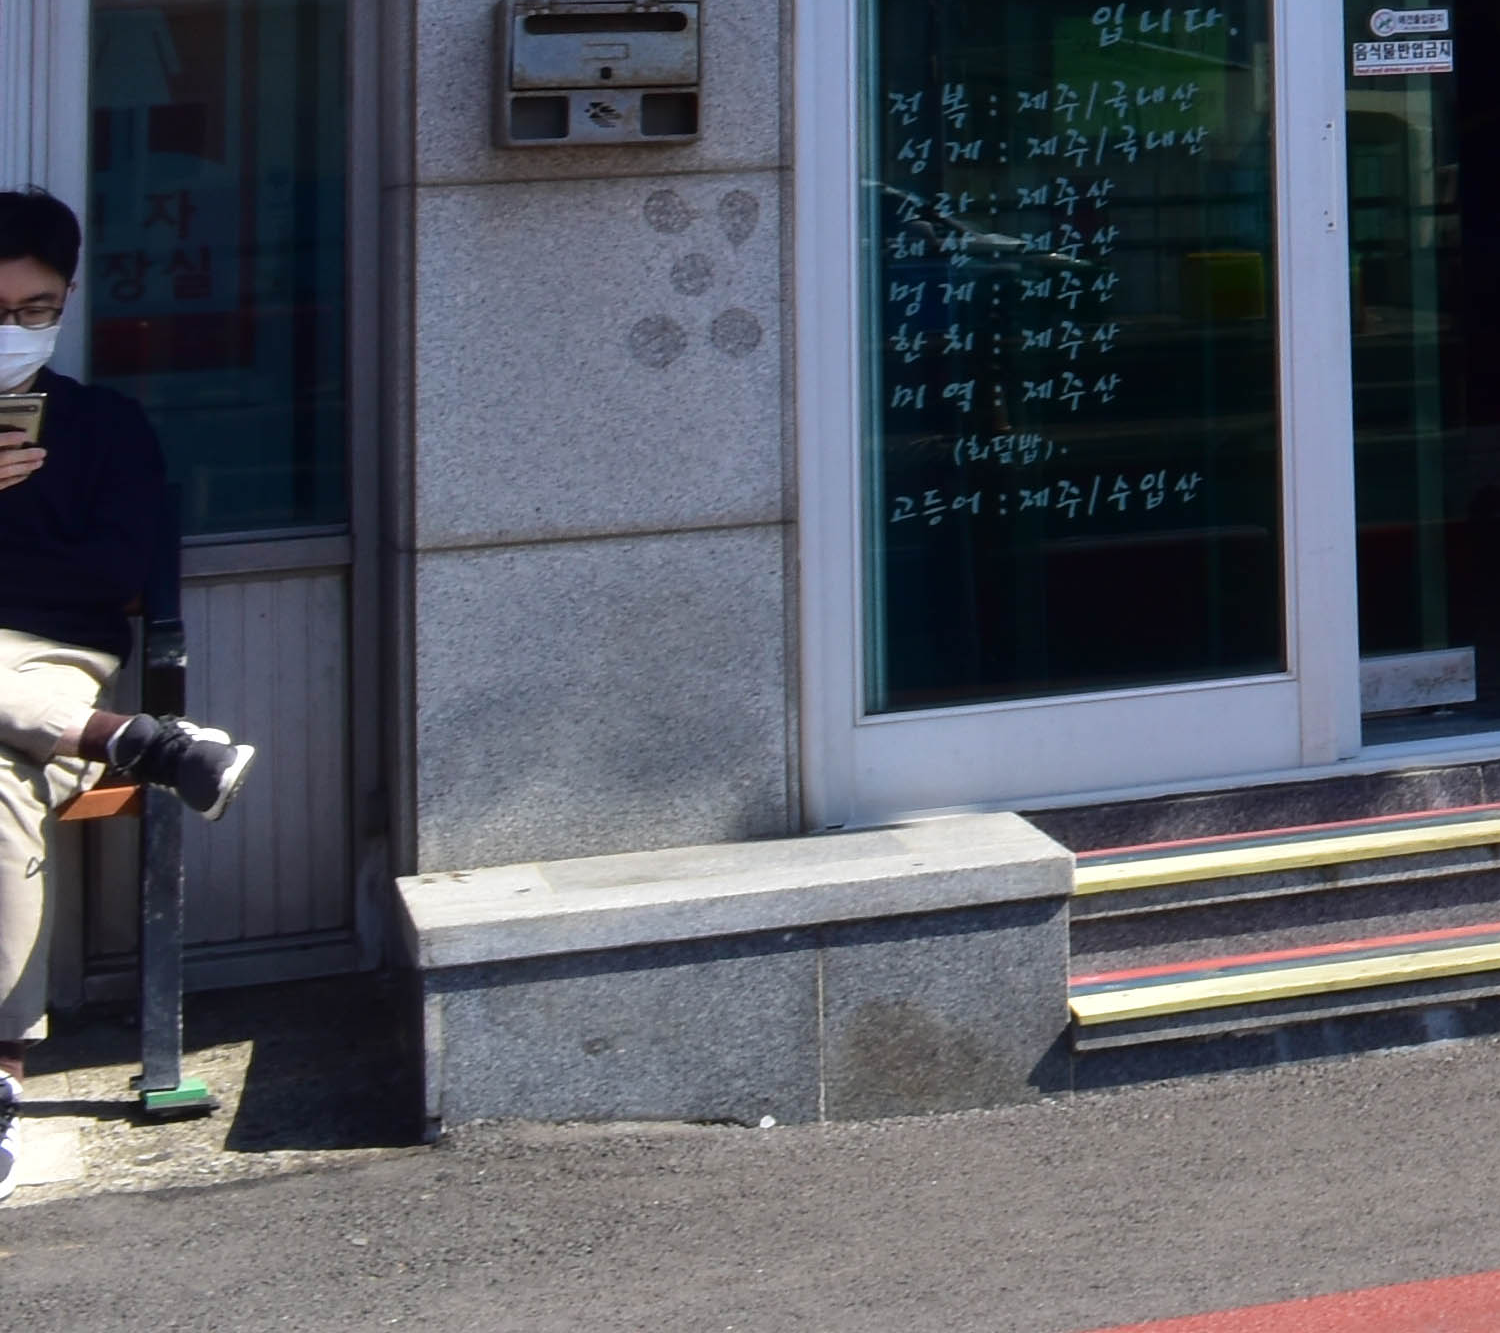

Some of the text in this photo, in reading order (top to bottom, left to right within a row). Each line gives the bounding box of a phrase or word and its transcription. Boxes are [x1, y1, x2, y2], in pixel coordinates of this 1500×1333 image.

[1355, 41, 1451, 61] 음식물반입금지
[1018, 176, 1115, 215] 제주산
[1021, 224, 1119, 264] 제주산
[1020, 270, 1120, 309] 제주산
[1020, 320, 1120, 360] 제주산
[1022, 371, 1122, 411] 제주산
[889, 488, 982, 525] 고등어
